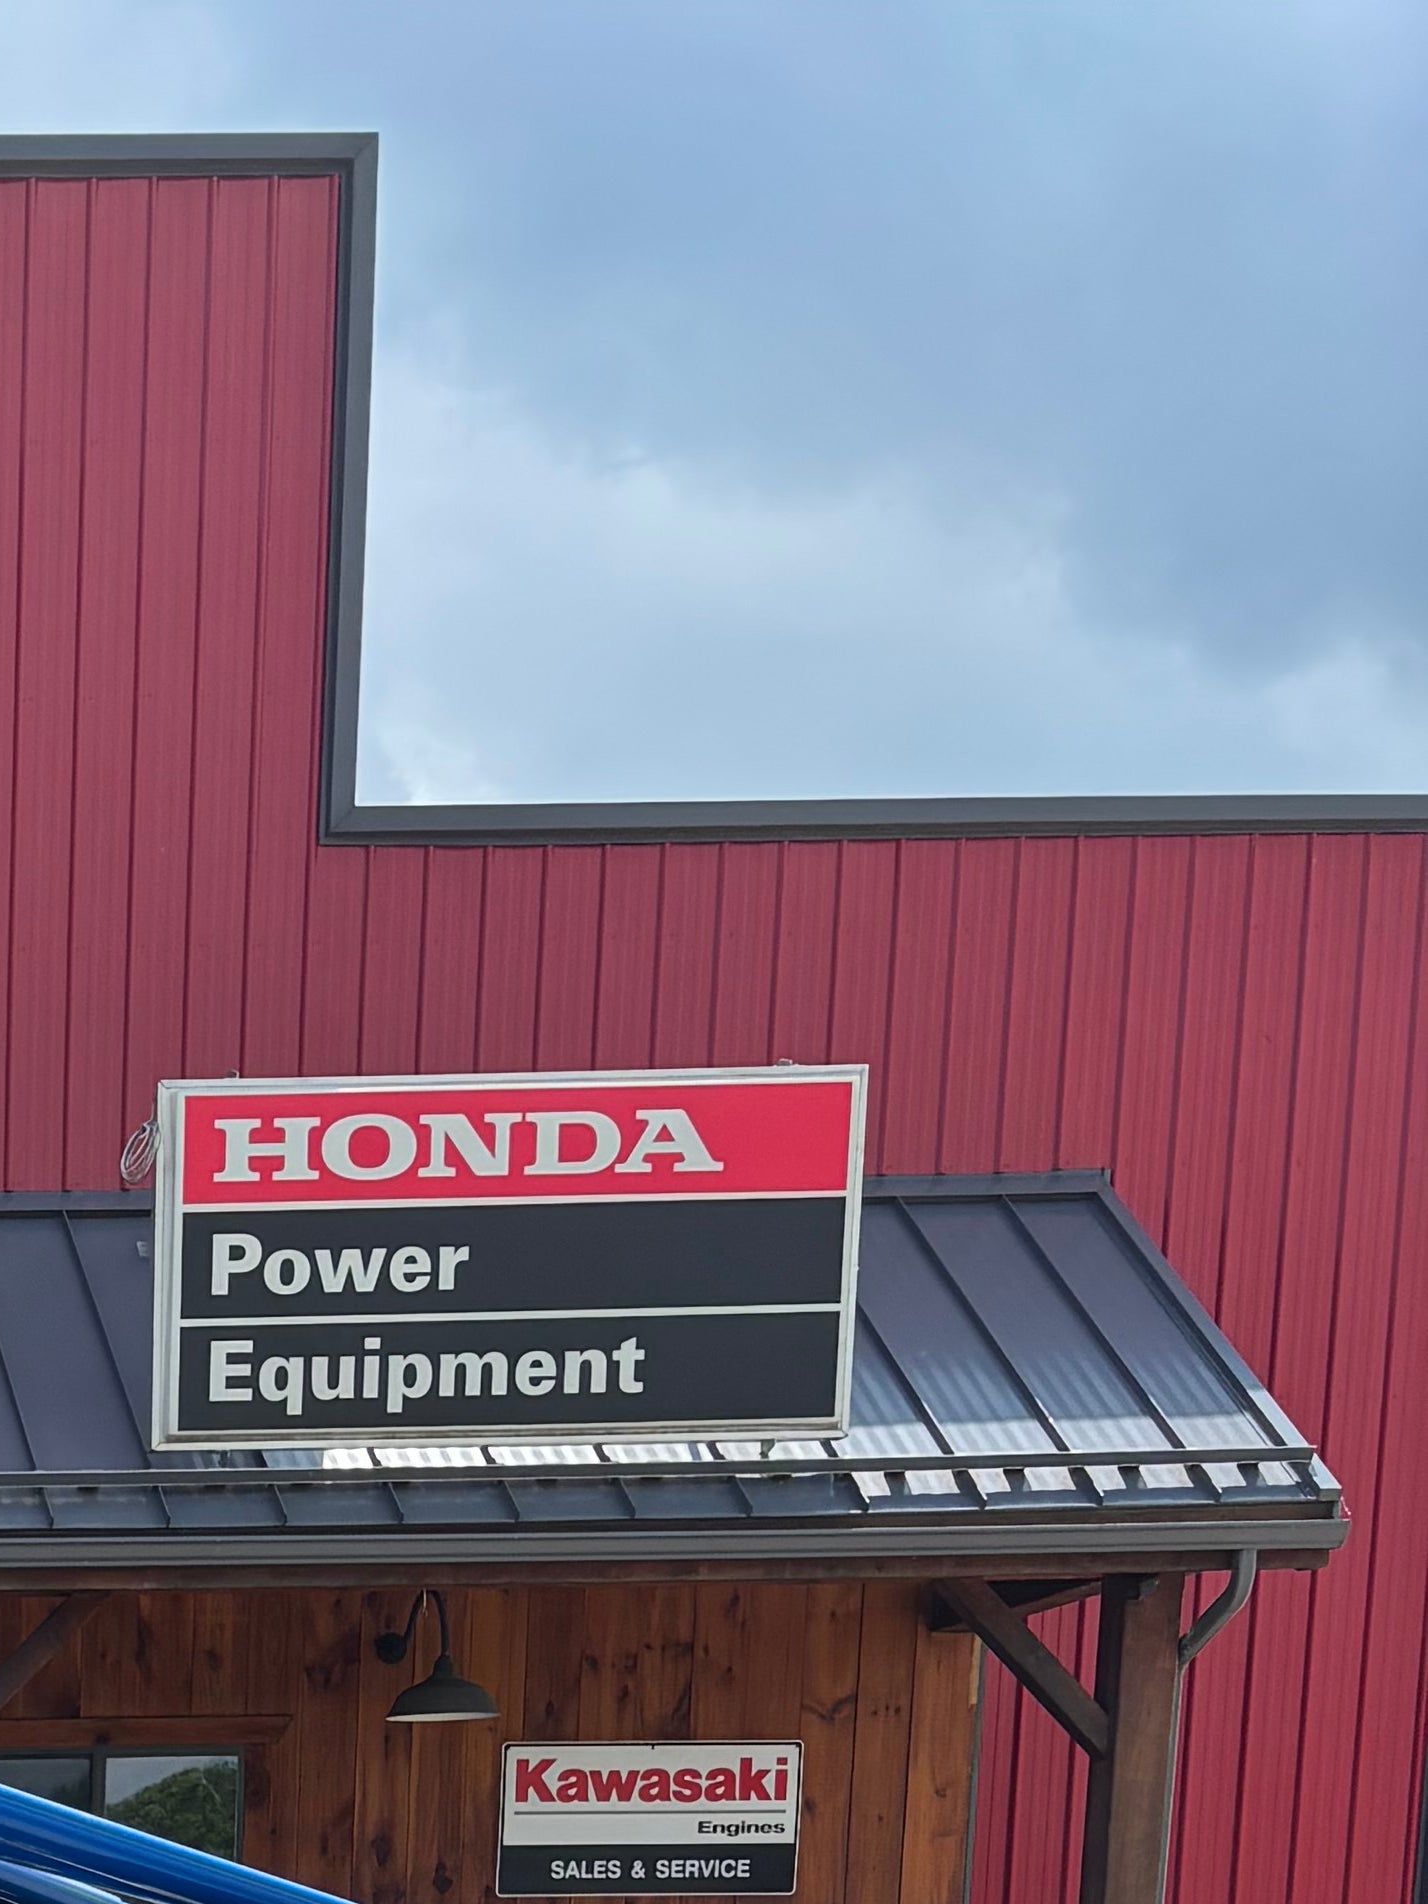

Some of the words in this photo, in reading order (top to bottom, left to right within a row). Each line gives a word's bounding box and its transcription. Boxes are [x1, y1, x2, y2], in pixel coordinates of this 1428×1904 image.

[212, 1109, 724, 1183] HONDA
[210, 1233, 470, 1297] Power
[207, 1336, 646, 1416] Equipment
[514, 1757, 789, 1803] Kawasaki
[697, 1820, 786, 1837] Engines
[550, 1860, 622, 1880] SALES
[630, 1860, 646, 1880] &
[655, 1859, 751, 1879] SERVICE
